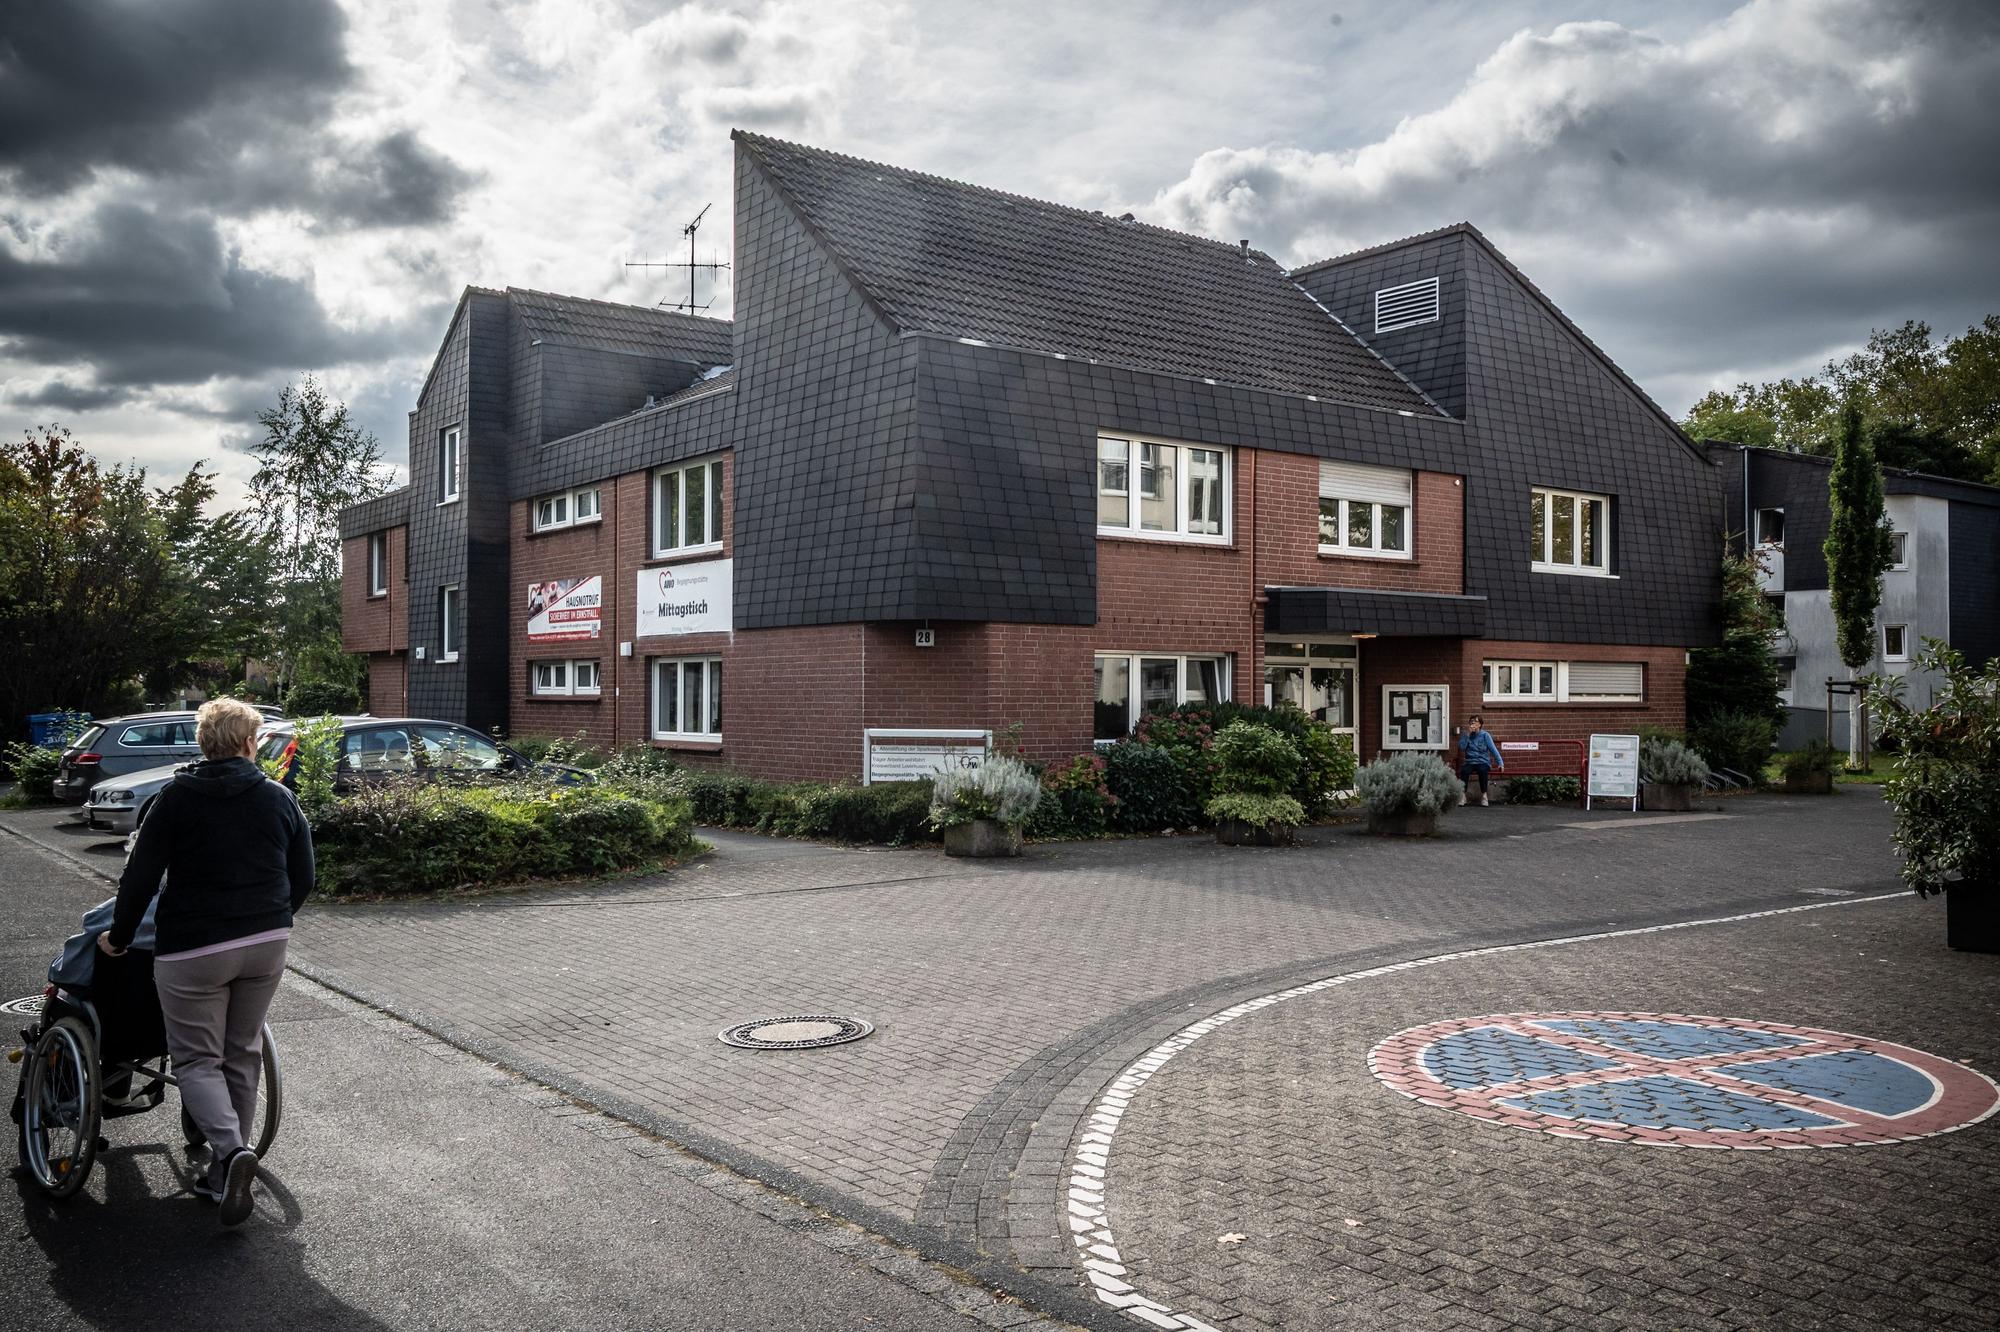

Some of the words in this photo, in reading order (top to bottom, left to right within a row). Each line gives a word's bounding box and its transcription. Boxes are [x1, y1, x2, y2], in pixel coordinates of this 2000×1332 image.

[664, 579, 674, 588] AWO
[566, 594, 599, 608] HAUSNOTRUF
[658, 599, 708, 618] Mittagstisch
[549, 611, 570, 621] SICHERHEIT
[918, 631, 931, 643] 28
